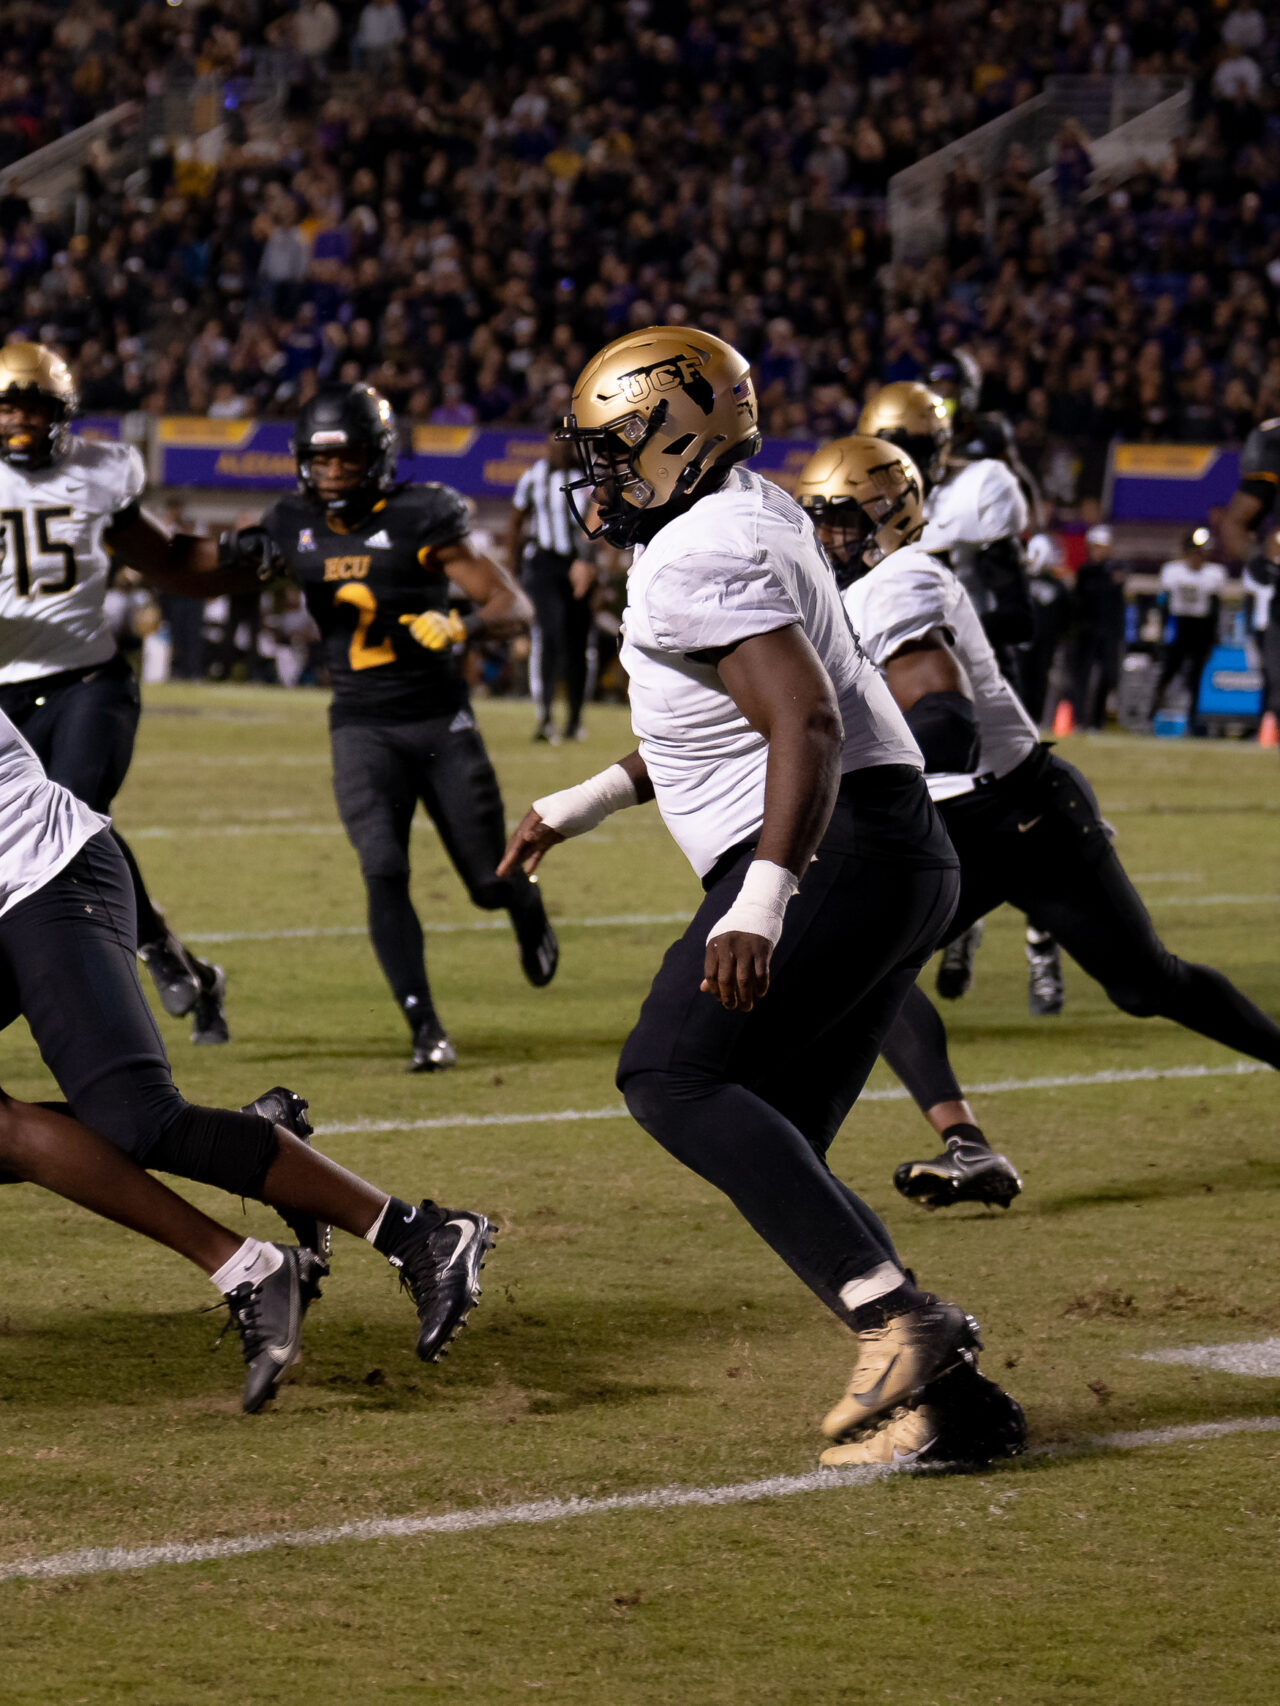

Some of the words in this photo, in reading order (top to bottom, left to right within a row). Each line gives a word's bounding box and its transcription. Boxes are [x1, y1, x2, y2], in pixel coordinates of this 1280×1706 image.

[619, 356, 704, 404] UCF
[323, 555, 371, 582] ECU
[333, 581, 397, 672] 2
